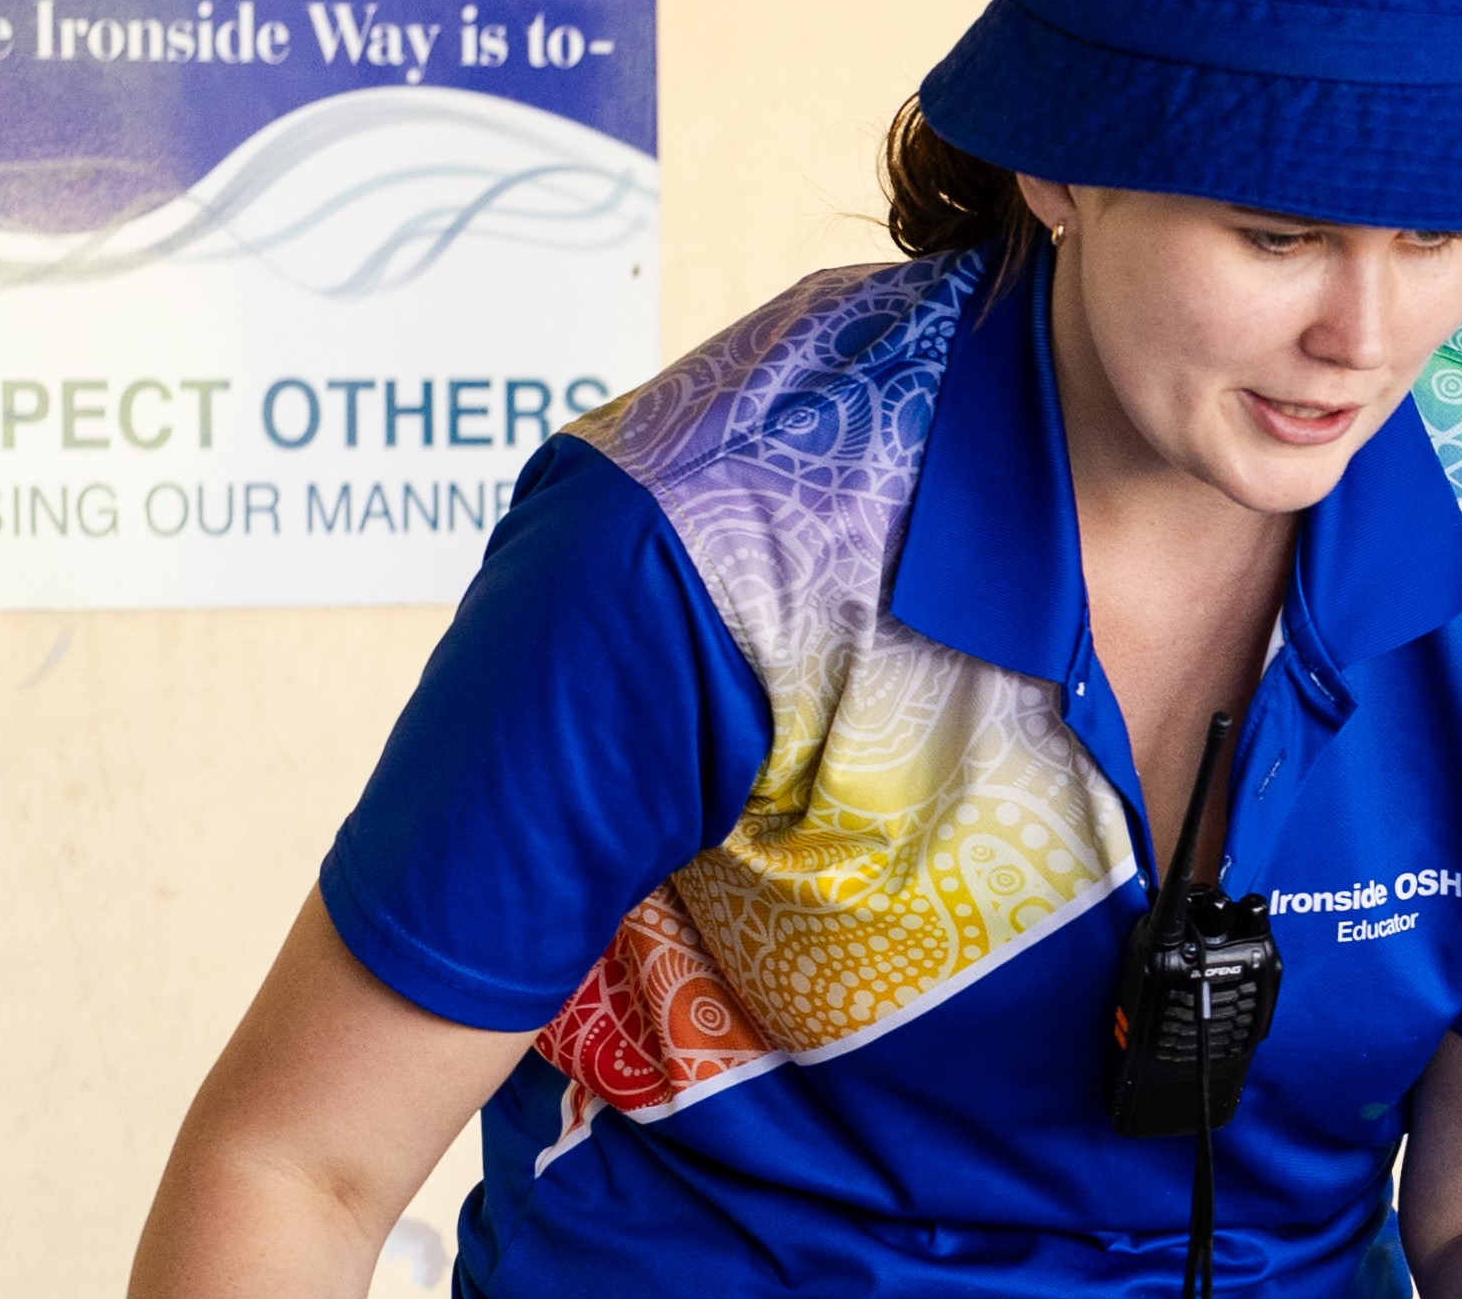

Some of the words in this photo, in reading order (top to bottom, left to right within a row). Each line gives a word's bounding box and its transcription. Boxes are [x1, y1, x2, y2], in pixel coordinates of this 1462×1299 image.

[307, 2, 440, 85] Way
[461, 5, 509, 68] is
[144, 482, 282, 538] OUR
[1269, 880, 1388, 917] Ironside
[1337, 912, 1420, 943] Educator
